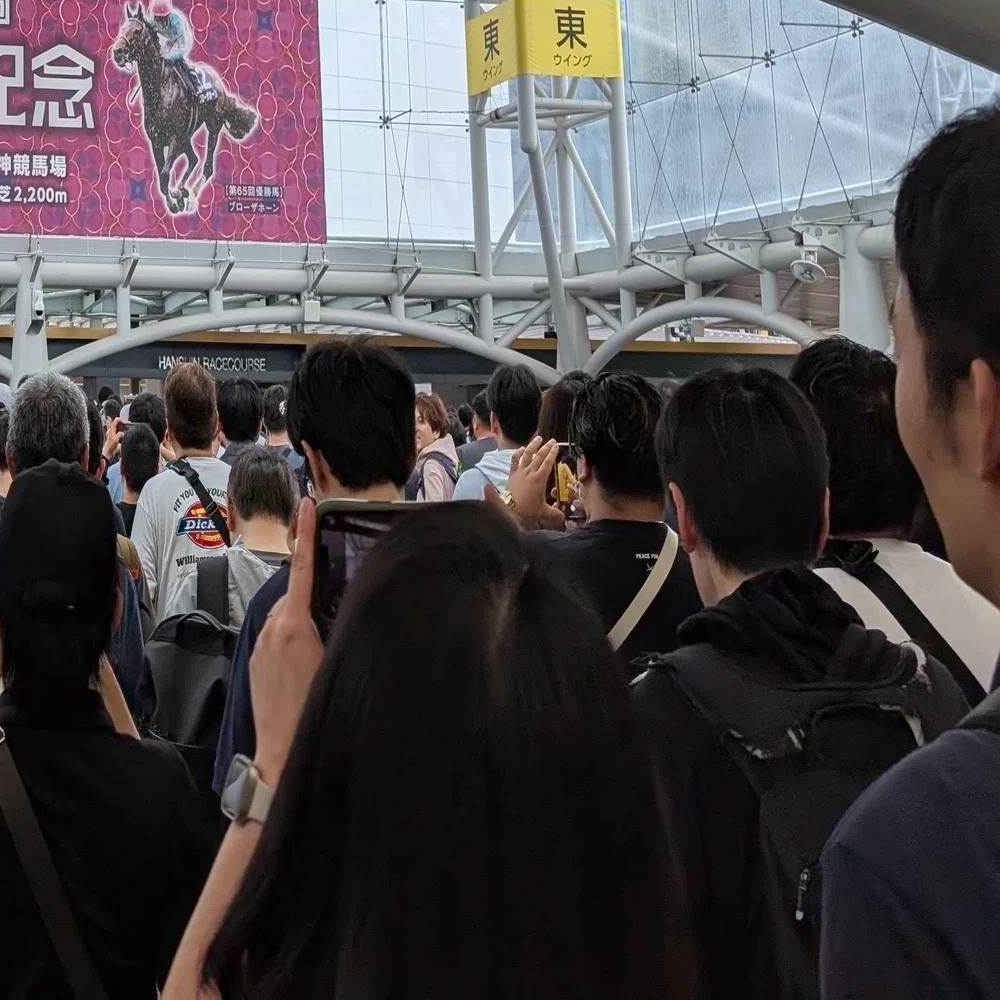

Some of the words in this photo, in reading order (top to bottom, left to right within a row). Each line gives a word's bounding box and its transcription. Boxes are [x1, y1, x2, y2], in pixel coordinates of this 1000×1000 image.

[554, 6, 588, 49] 東
[482, 18, 500, 63] 東
[553, 53, 593, 68] ウイング
[482, 60, 503, 81] ウイング
[13, 186, 67, 204] 2,200m
[229, 201, 279, 213] ブローザホーン
[203, 357, 266, 371] RACECOURSE
[173, 497, 182, 513] FIT
